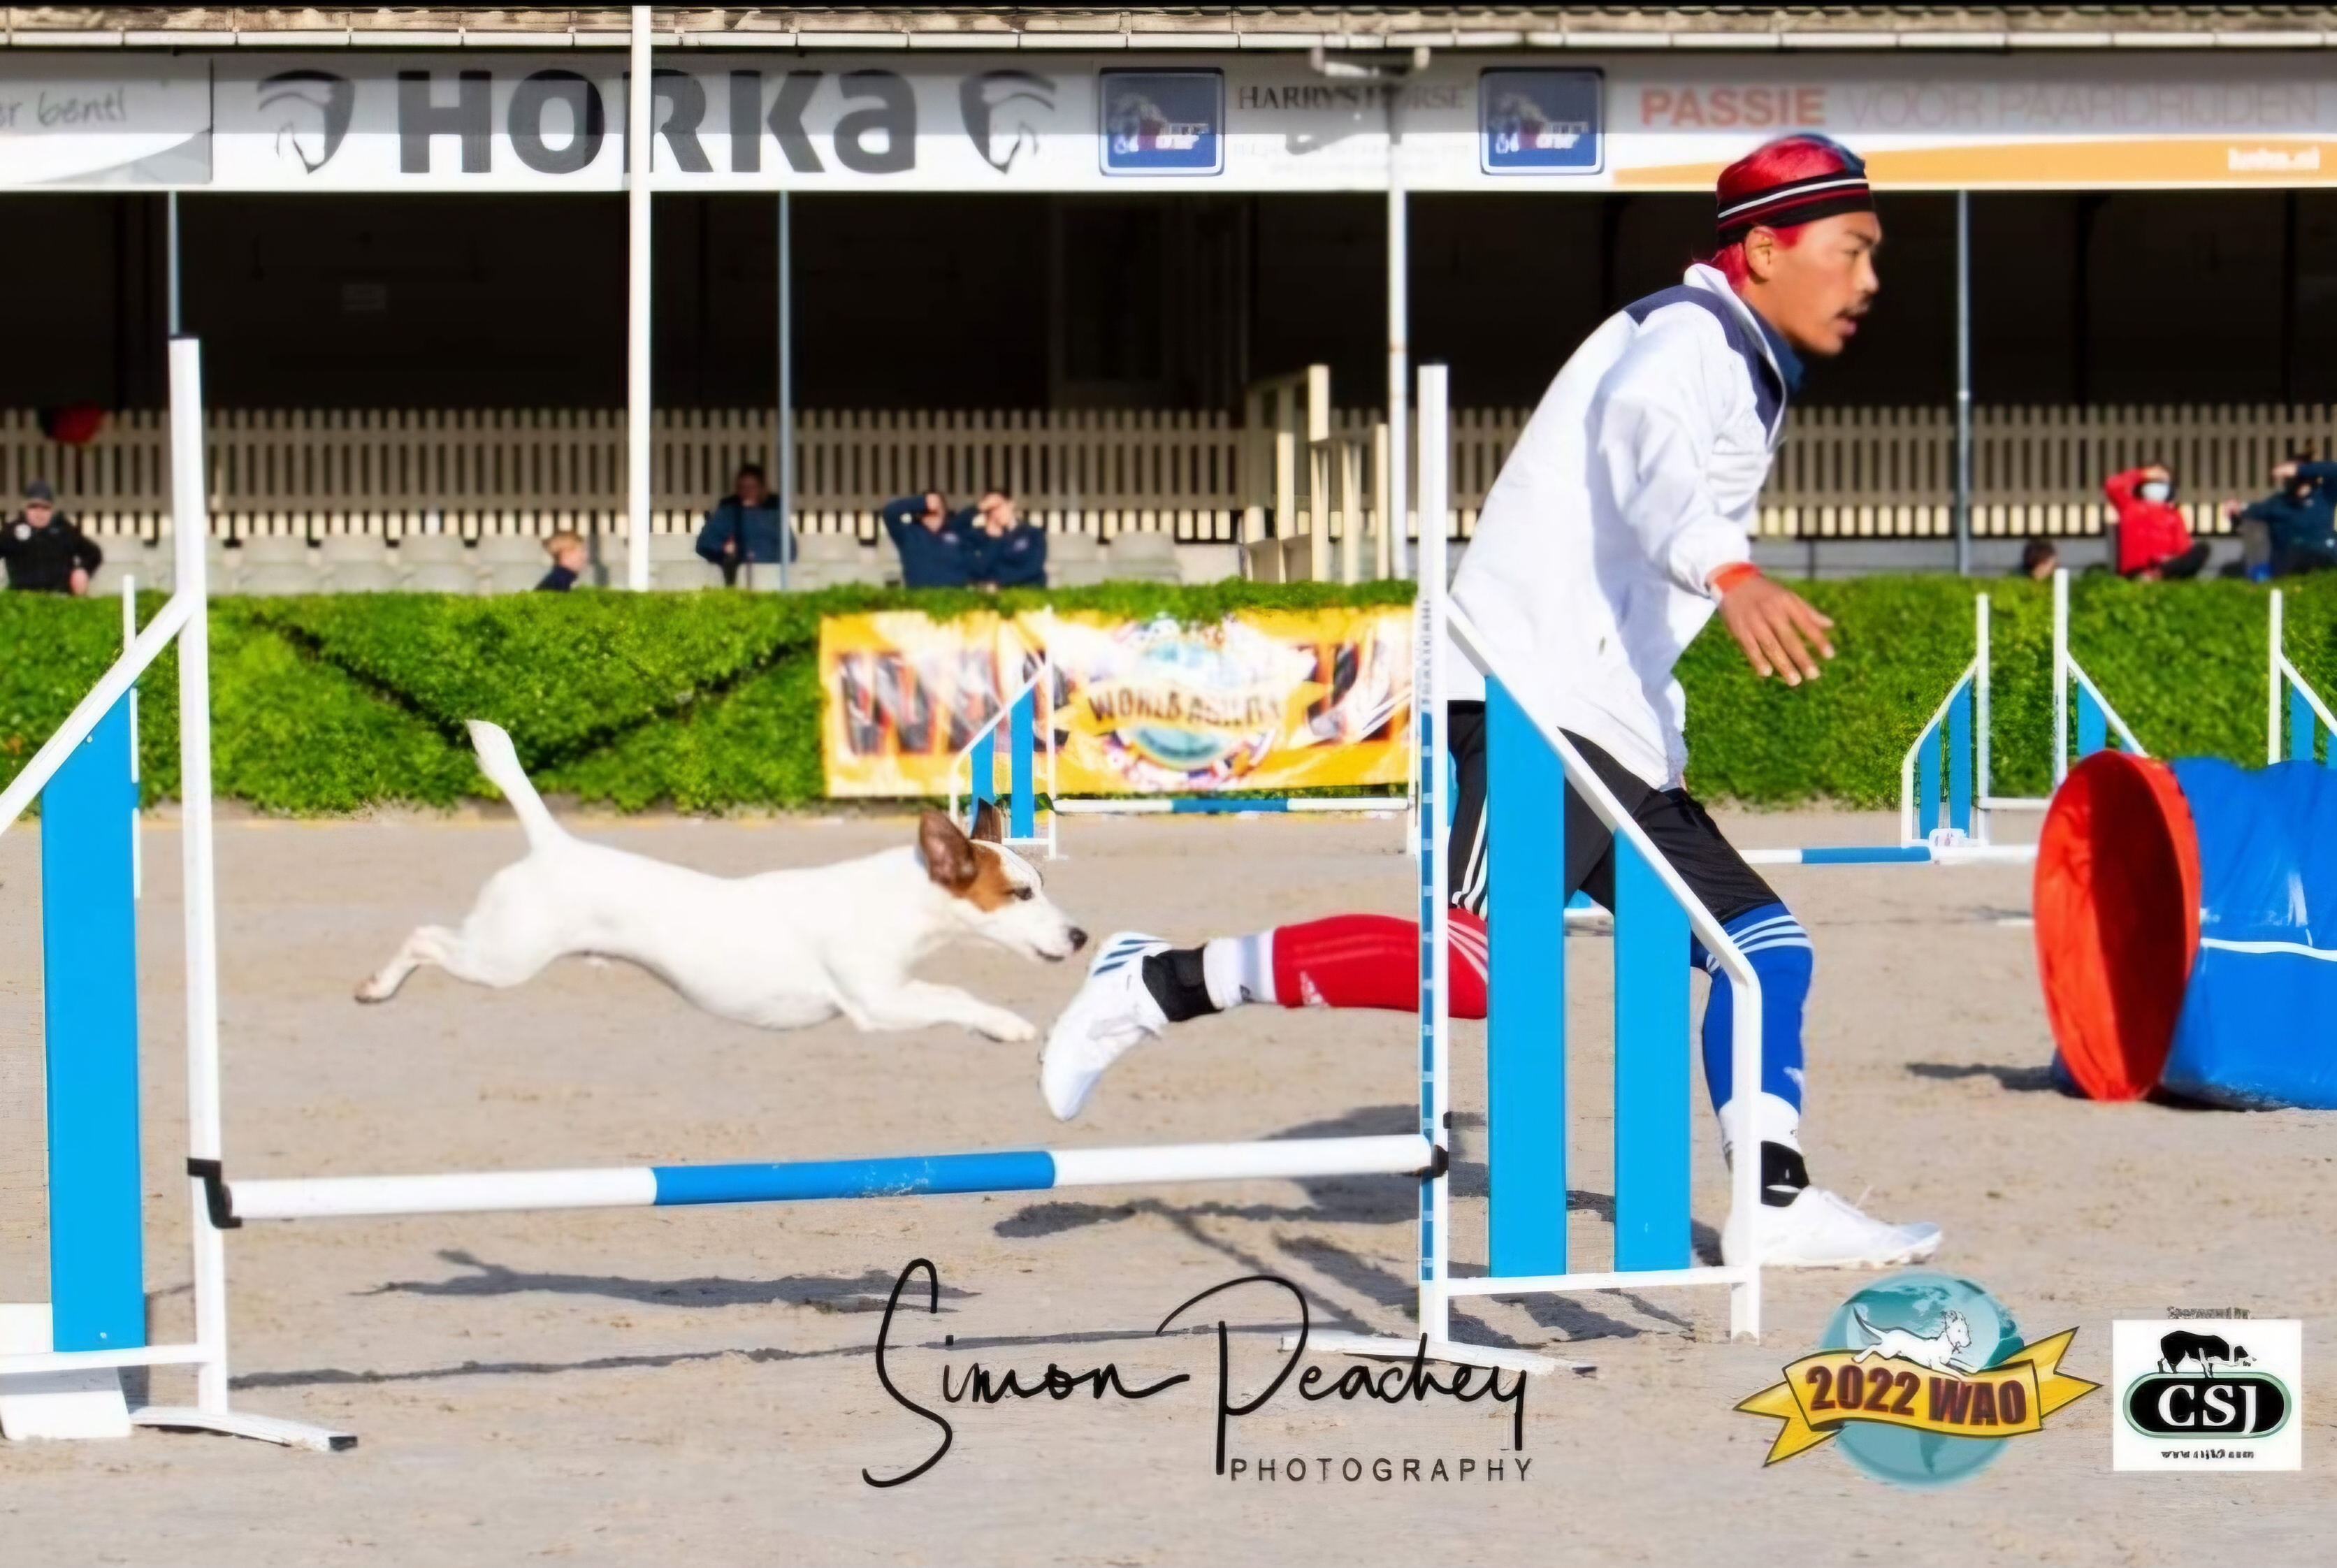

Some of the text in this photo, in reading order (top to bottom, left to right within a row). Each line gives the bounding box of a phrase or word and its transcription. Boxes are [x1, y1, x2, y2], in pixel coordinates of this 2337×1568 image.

[1363, 86, 1466, 110] HRSE
[1640, 84, 2318, 126] PASSIE VOOR PAARDRIJDEN
